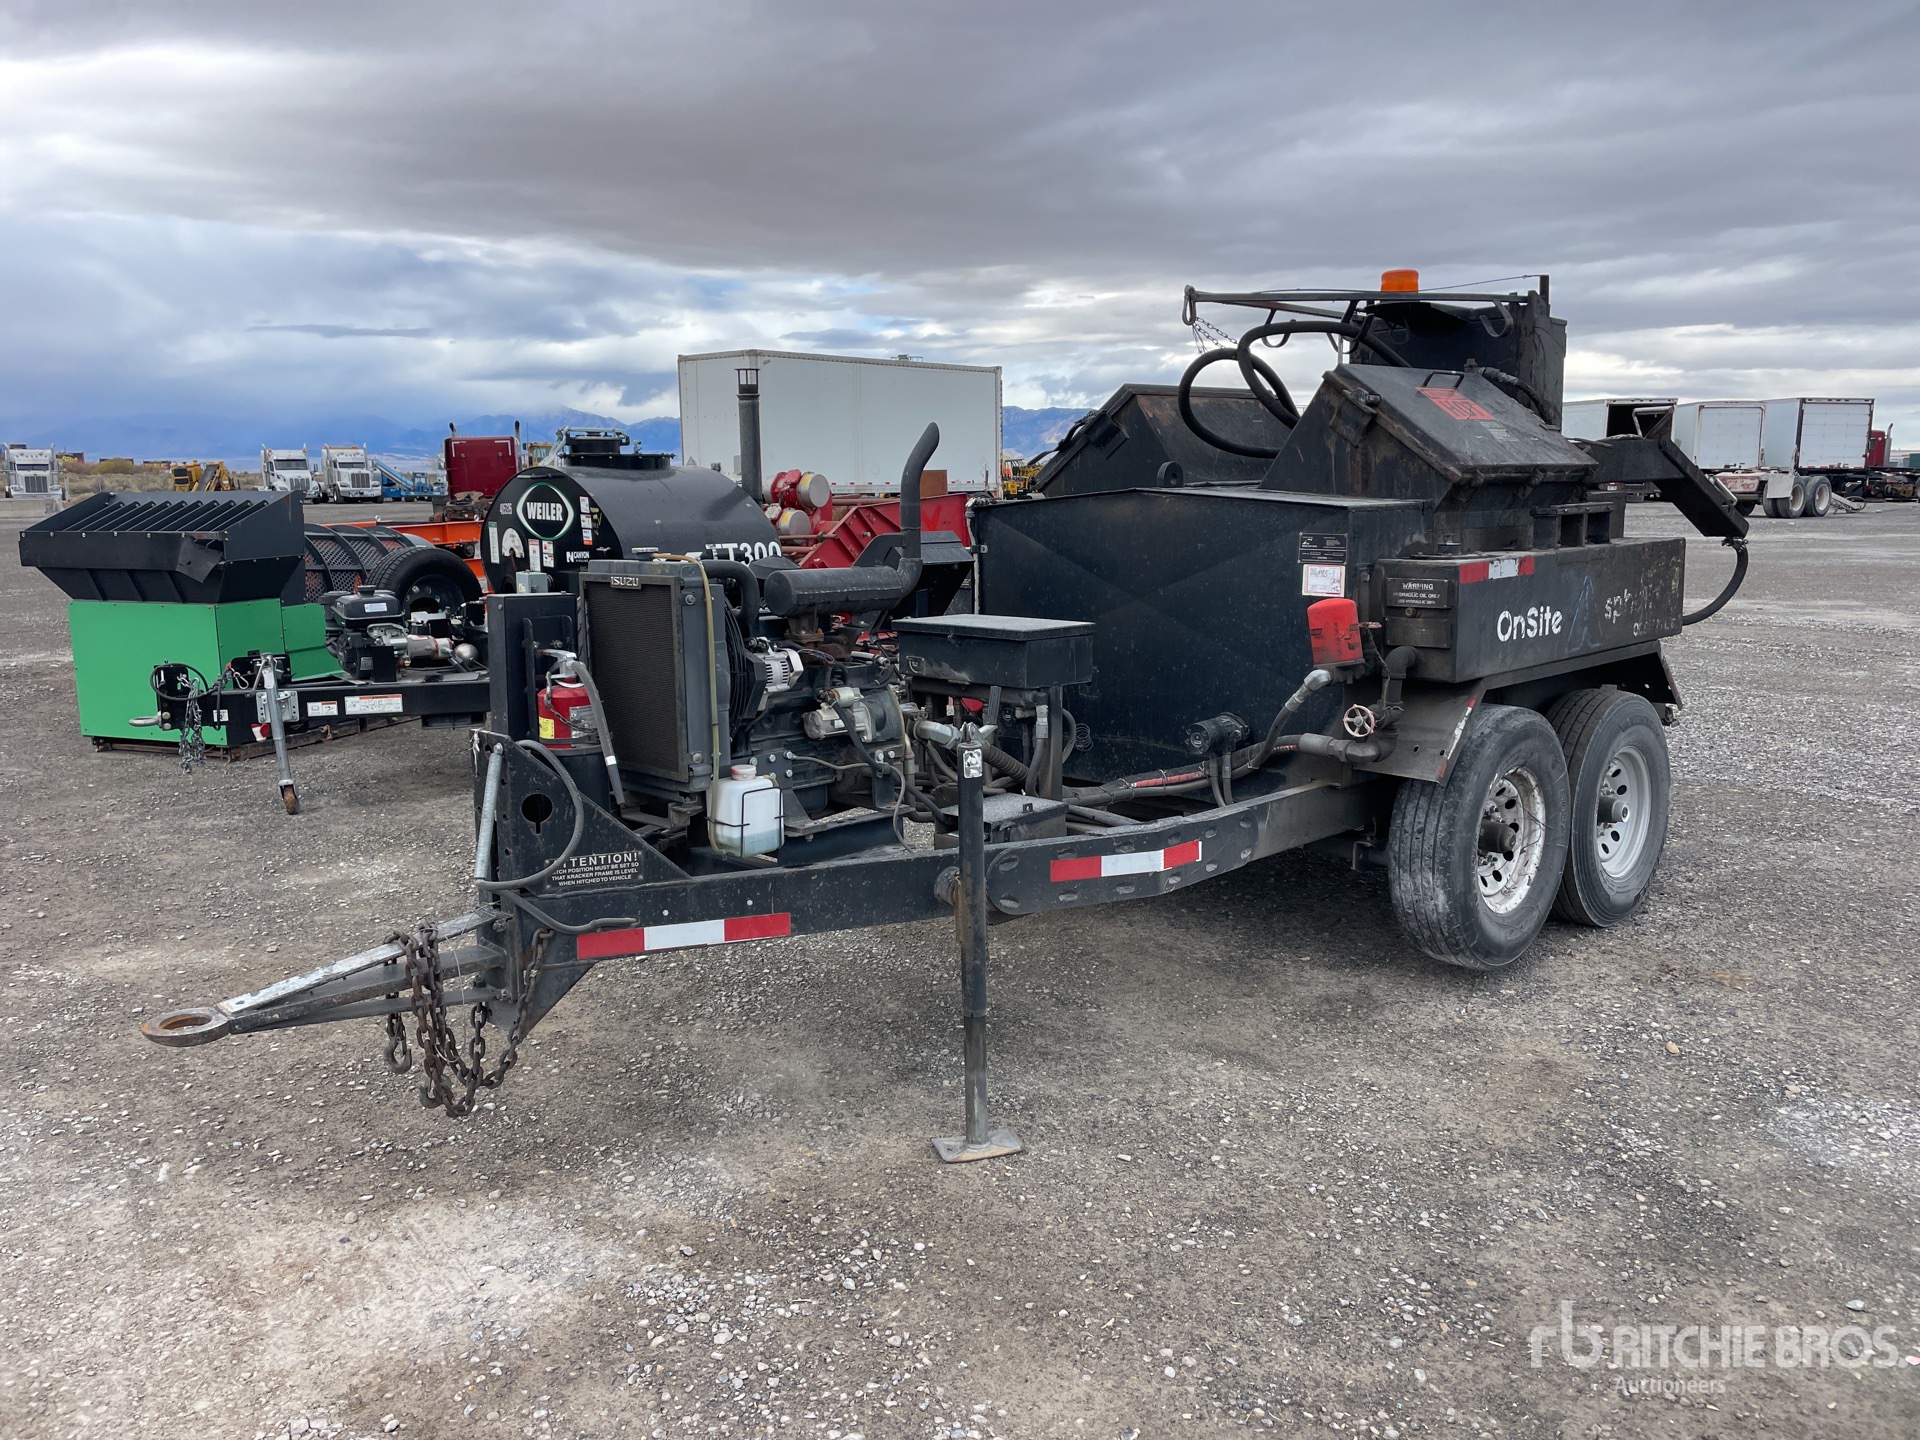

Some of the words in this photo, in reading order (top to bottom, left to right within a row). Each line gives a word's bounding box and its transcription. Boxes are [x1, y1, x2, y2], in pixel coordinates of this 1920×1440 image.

[526, 501, 563, 521] WEILER
[705, 541, 782, 567] TT300
[610, 576, 639, 587] ISUZU
[1401, 582, 1434, 590] WARNING
[1497, 605, 1563, 642] OnSite
[563, 852, 638, 868] TENTION!
[567, 866, 594, 874] POSITION
[594, 864, 610, 872] MUST
[576, 877, 601, 885] HITCHED
[608, 874, 632, 882] VEHICLE
